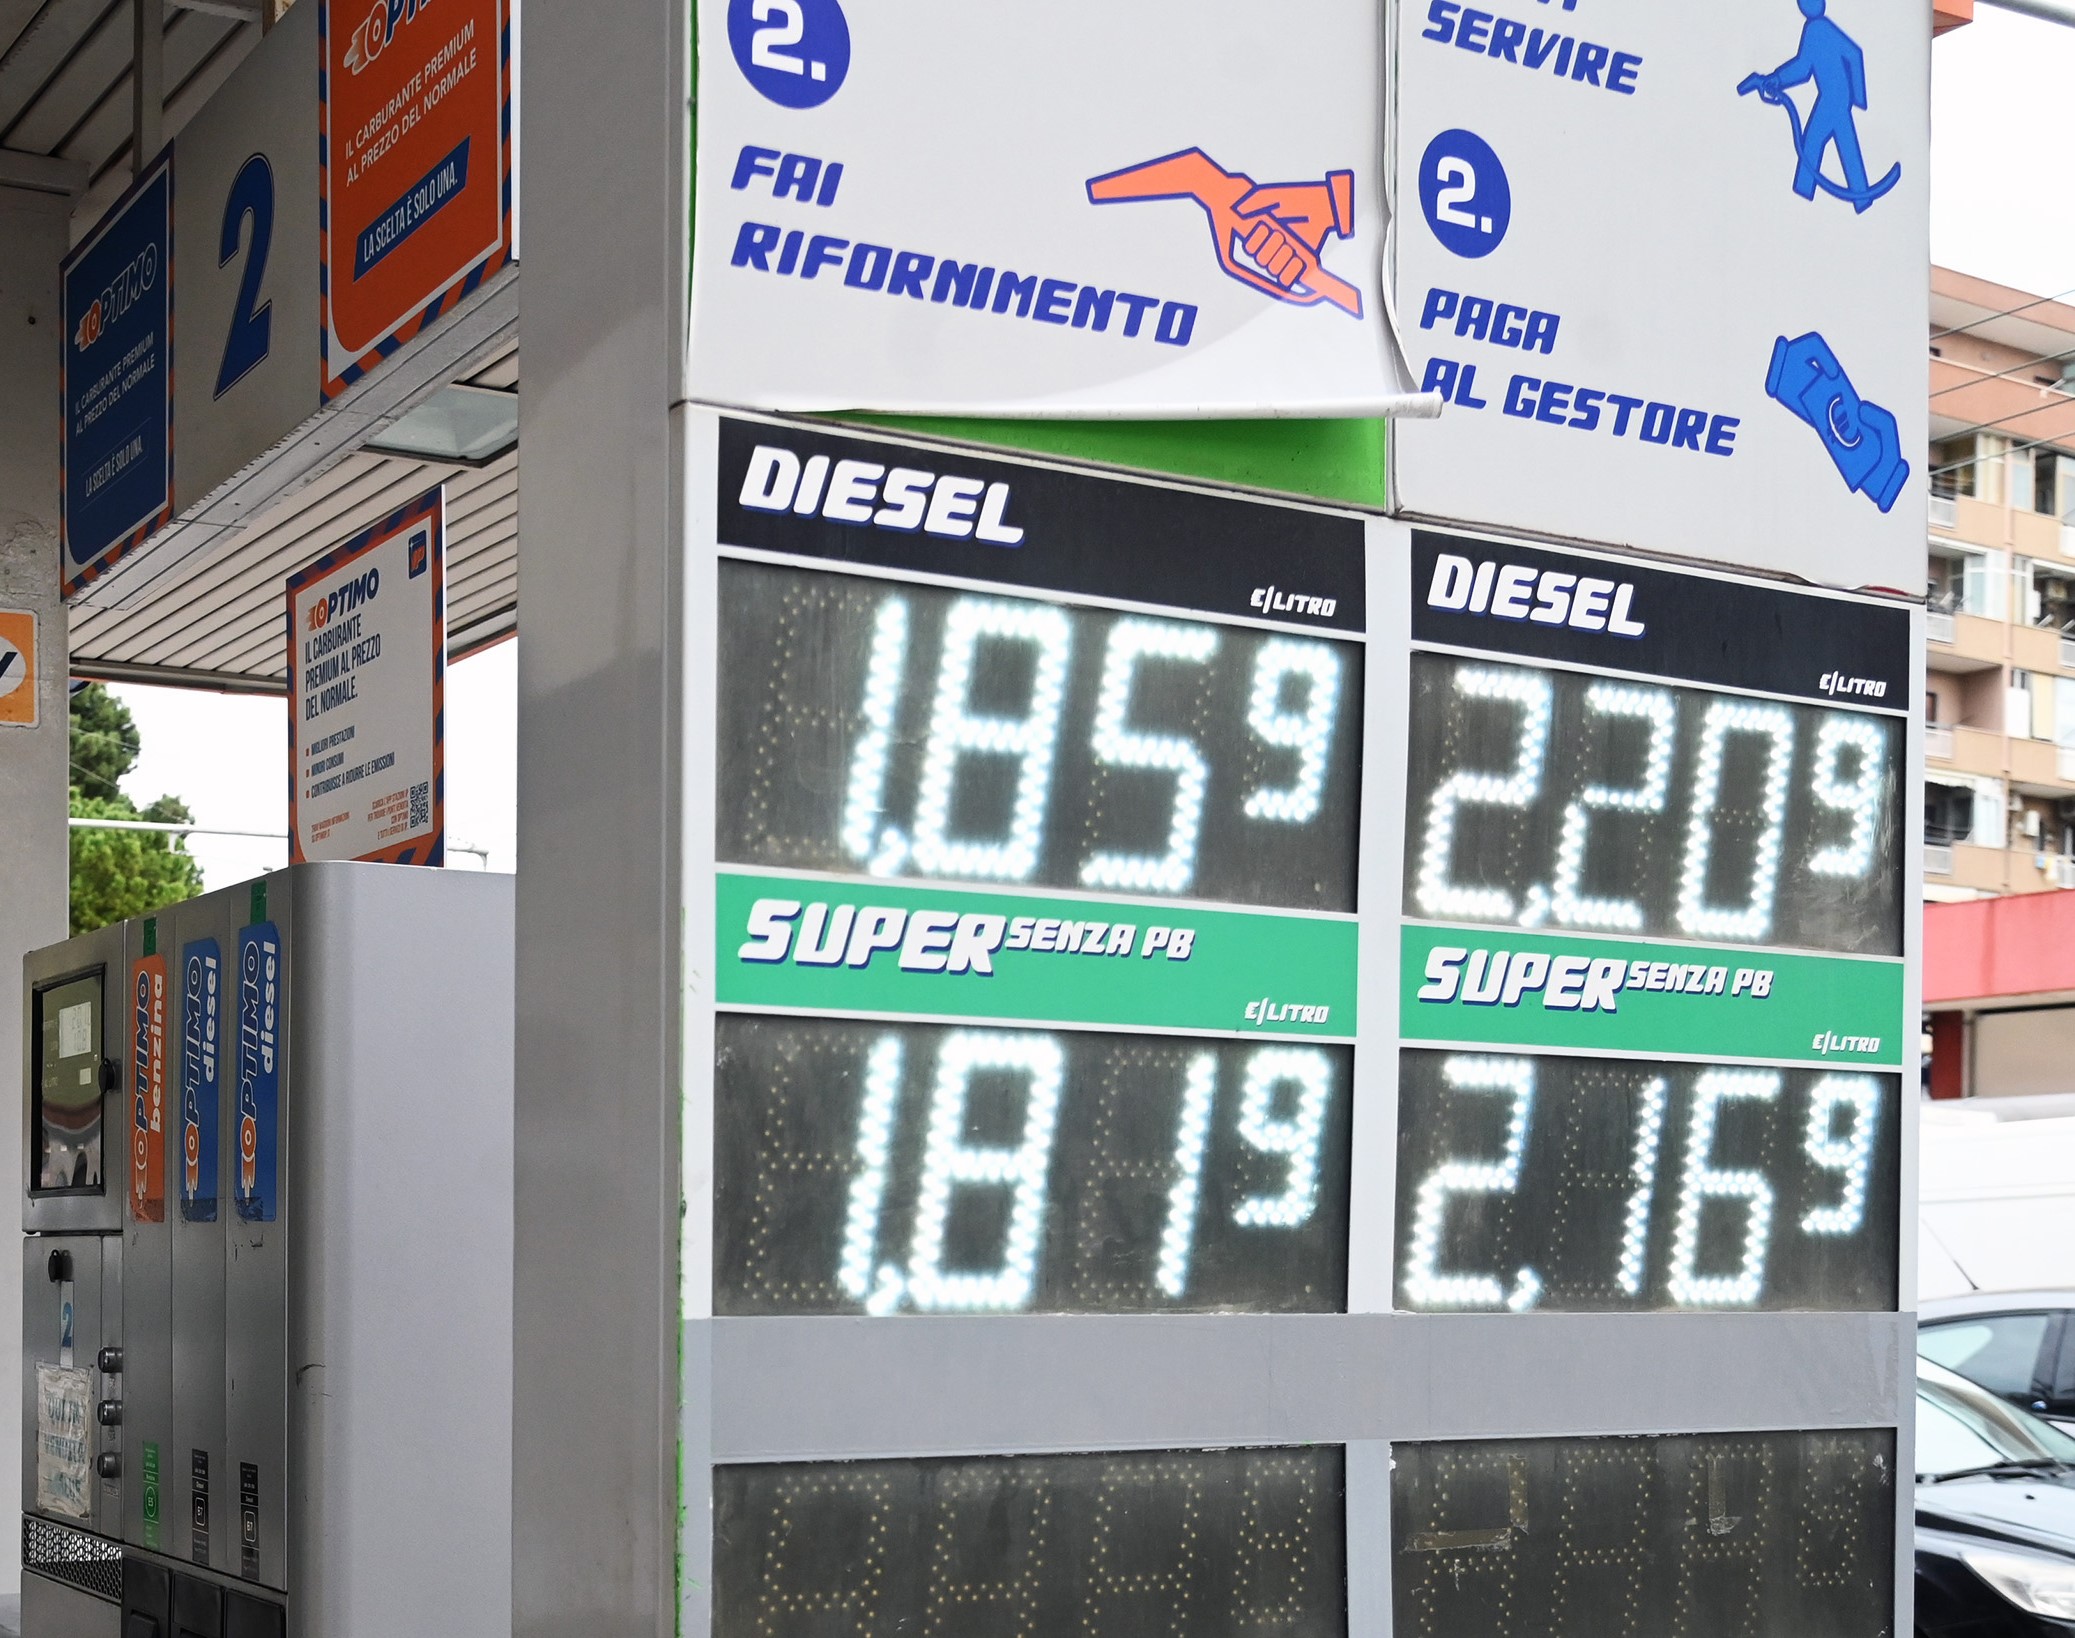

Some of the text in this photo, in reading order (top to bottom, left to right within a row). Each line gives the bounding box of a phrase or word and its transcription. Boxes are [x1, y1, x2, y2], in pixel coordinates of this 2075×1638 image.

[345, 139, 354, 160] IL
[356, 71, 422, 148] CARBURANTE
[425, 18, 475, 84] PREMIUM
[751, 0, 826, 82] 2.
[1421, 0, 1643, 96] SERVIRE
[346, 47, 477, 187] AL PREZZO DEL NORMALE
[364, 161, 458, 263] LA SCELTA È SOLO UNA.
[730, 144, 844, 207] FAI
[1436, 155, 1493, 234] 2.
[87, 242, 158, 344] OPTIMO
[214, 152, 275, 401] 2
[730, 221, 1198, 348] RIFORNIMENTO
[1420, 287, 1561, 355] PAGA
[76, 352, 155, 437] AL PREZZO DEL NORMALE
[81, 361, 122, 409] CARBURANTE
[122, 331, 154, 372] PREMIUM
[1421, 357, 1741, 457] AL GESTORE
[739, 445, 1027, 548] DIESEL
[305, 613, 361, 665] IL CARBURANTE
[313, 567, 379, 629] OPTIMO
[1427, 552, 1646, 640] DIESEL
[305, 633, 381, 693] PREMIUM AL PREZZO
[305, 675, 358, 721] DEL NORMALE.
[738, 898, 1195, 978] SUPER SENZA PB
[1417, 946, 1775, 1014] SUPER SENZA PB
[150, 974, 163, 1133] benzina
[203, 956, 217, 1083] diesel
[240, 941, 260, 1162] OPTIMO
[260, 941, 276, 1074] diesel
[134, 970, 150, 1170] OPTIMO
[184, 956, 202, 1166] OPTIMO
[61, 1302, 73, 1348] 2
